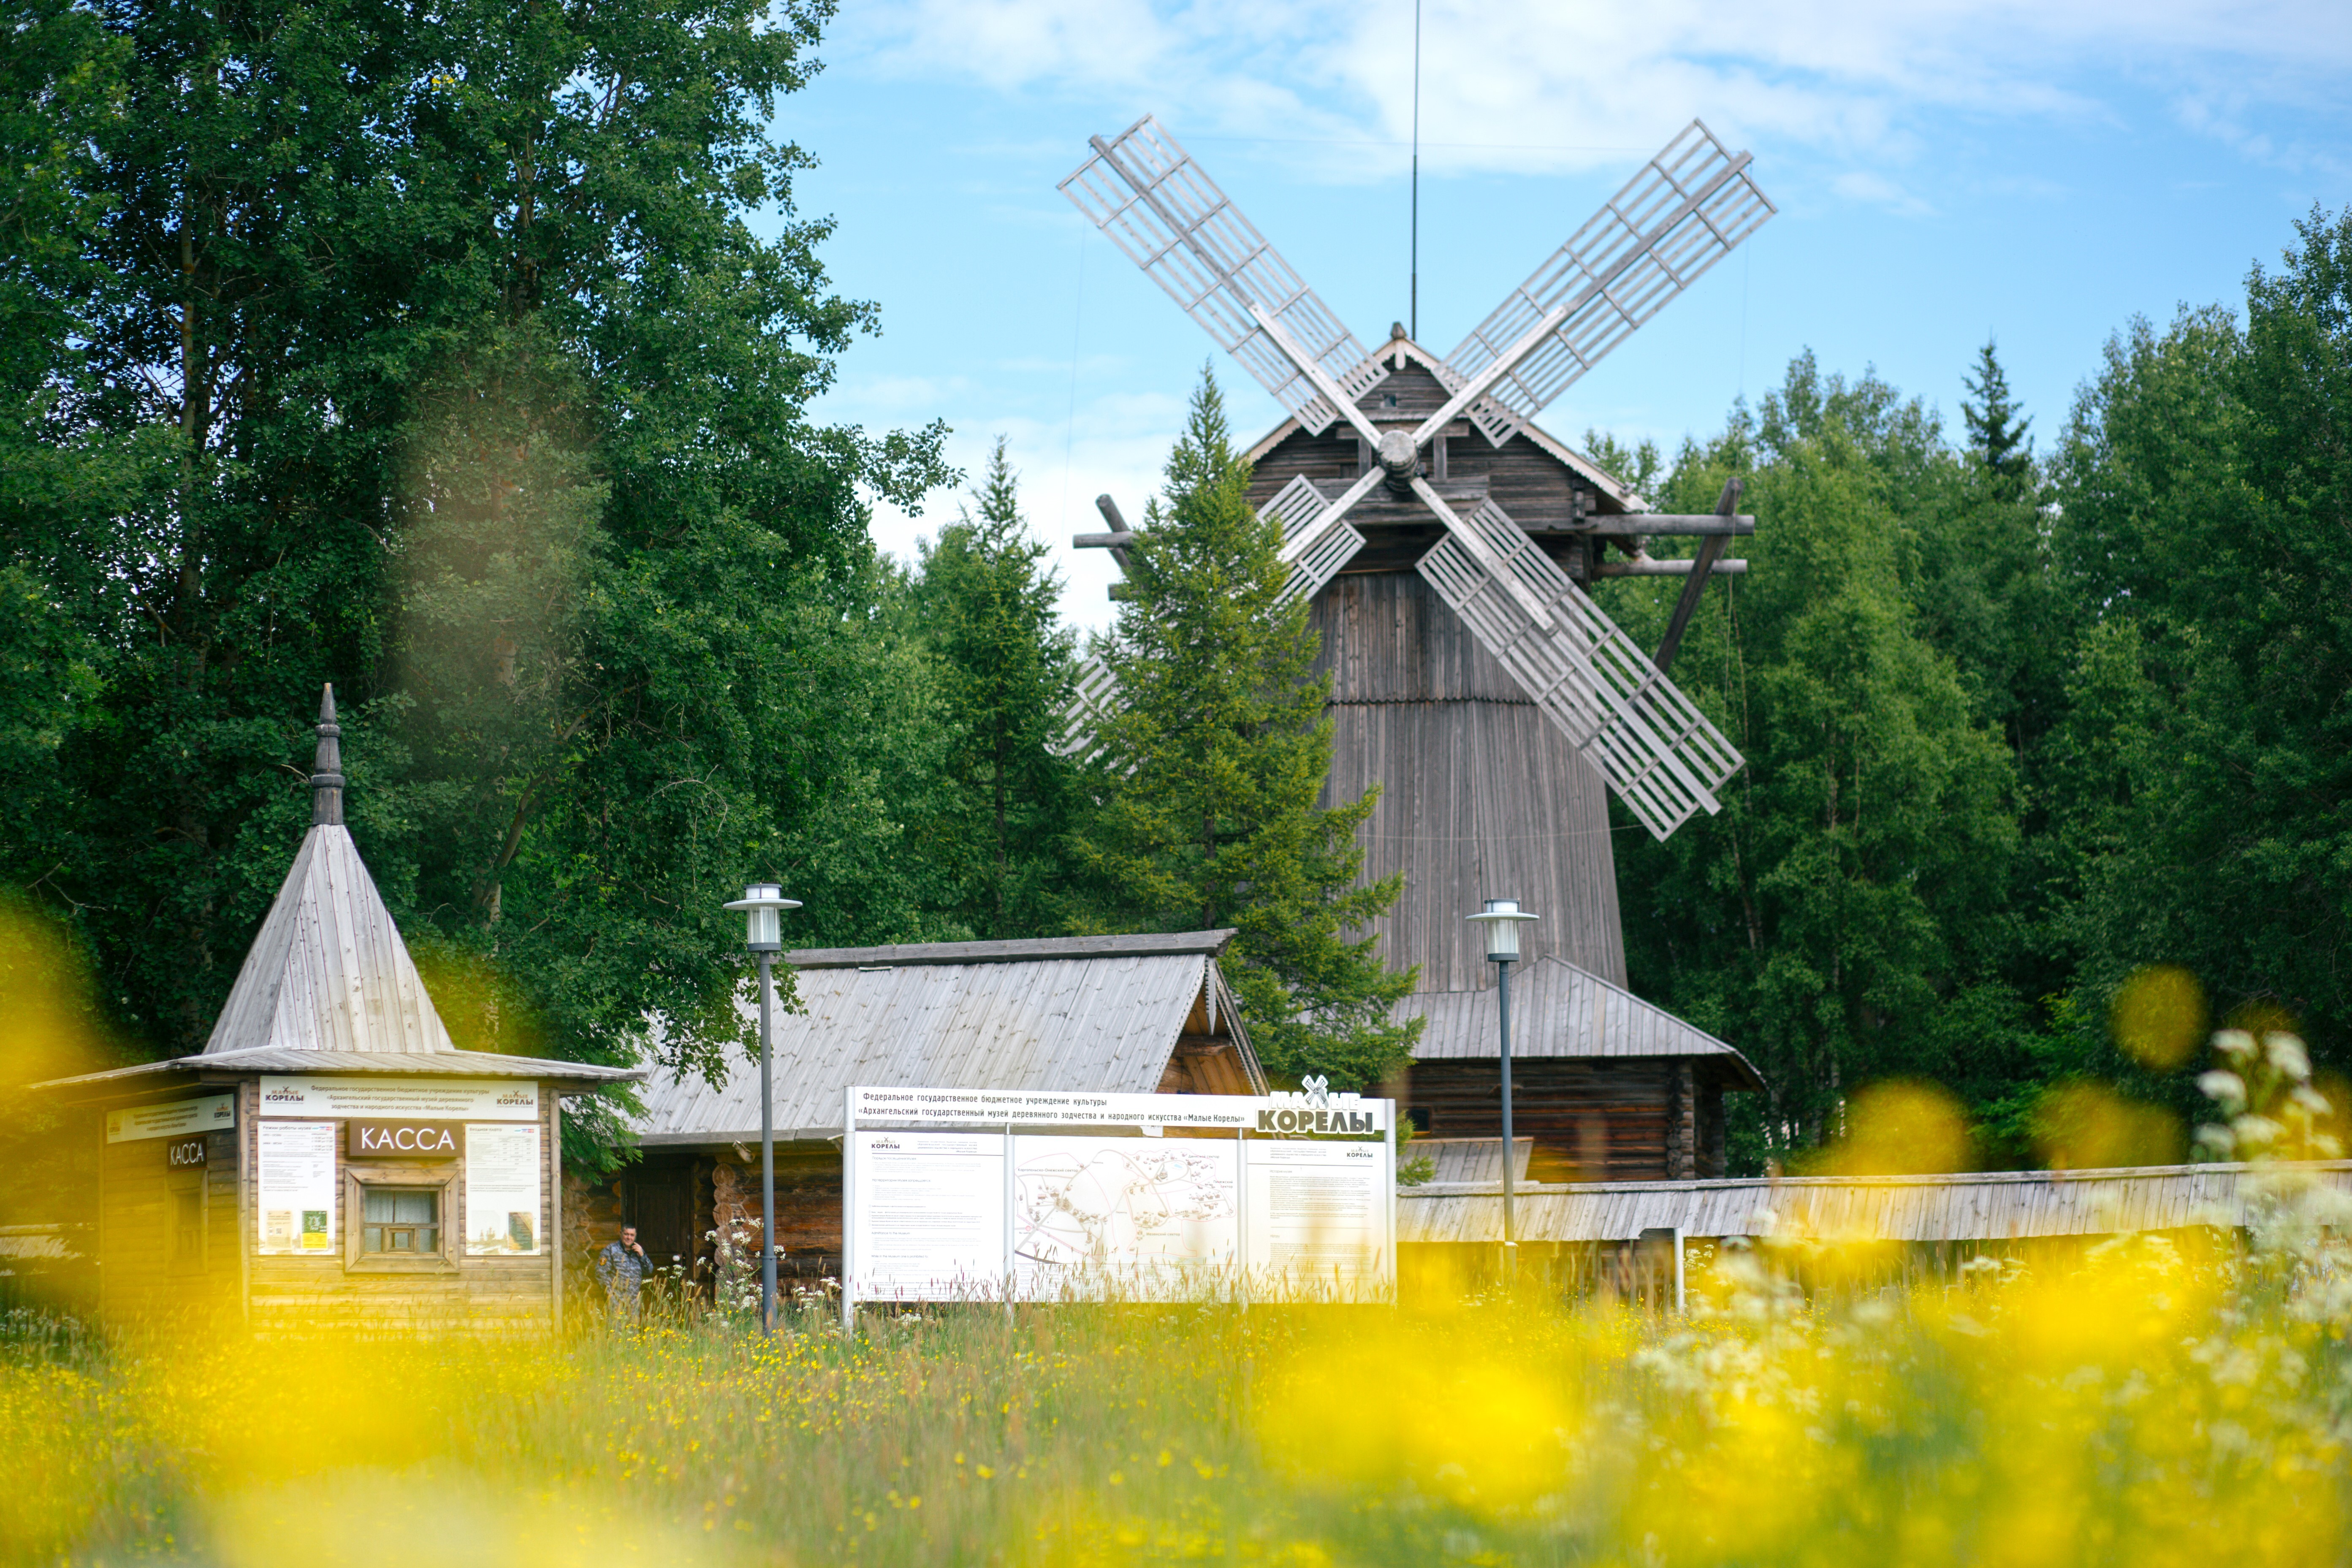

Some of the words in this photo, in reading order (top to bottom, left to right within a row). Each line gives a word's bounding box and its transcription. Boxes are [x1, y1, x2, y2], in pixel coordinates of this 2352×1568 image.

[863, 1093, 913, 1101] Федеральное
[981, 1095, 1022, 1104] бюджетное
[1026, 1097, 1069, 1105] учреждение
[858, 1107, 918, 1115] «Архангельский
[922, 1108, 984, 1117] государственный
[988, 1110, 1008, 1118] музей
[1183, 1114, 1211, 1122] «Малые
[1213, 1115, 1245, 1123] Корелы»
[1258, 1110, 1373, 1132] КОРЕЛЫ
[362, 1128, 455, 1150] КАССА
[171, 1142, 204, 1165] КАССА
